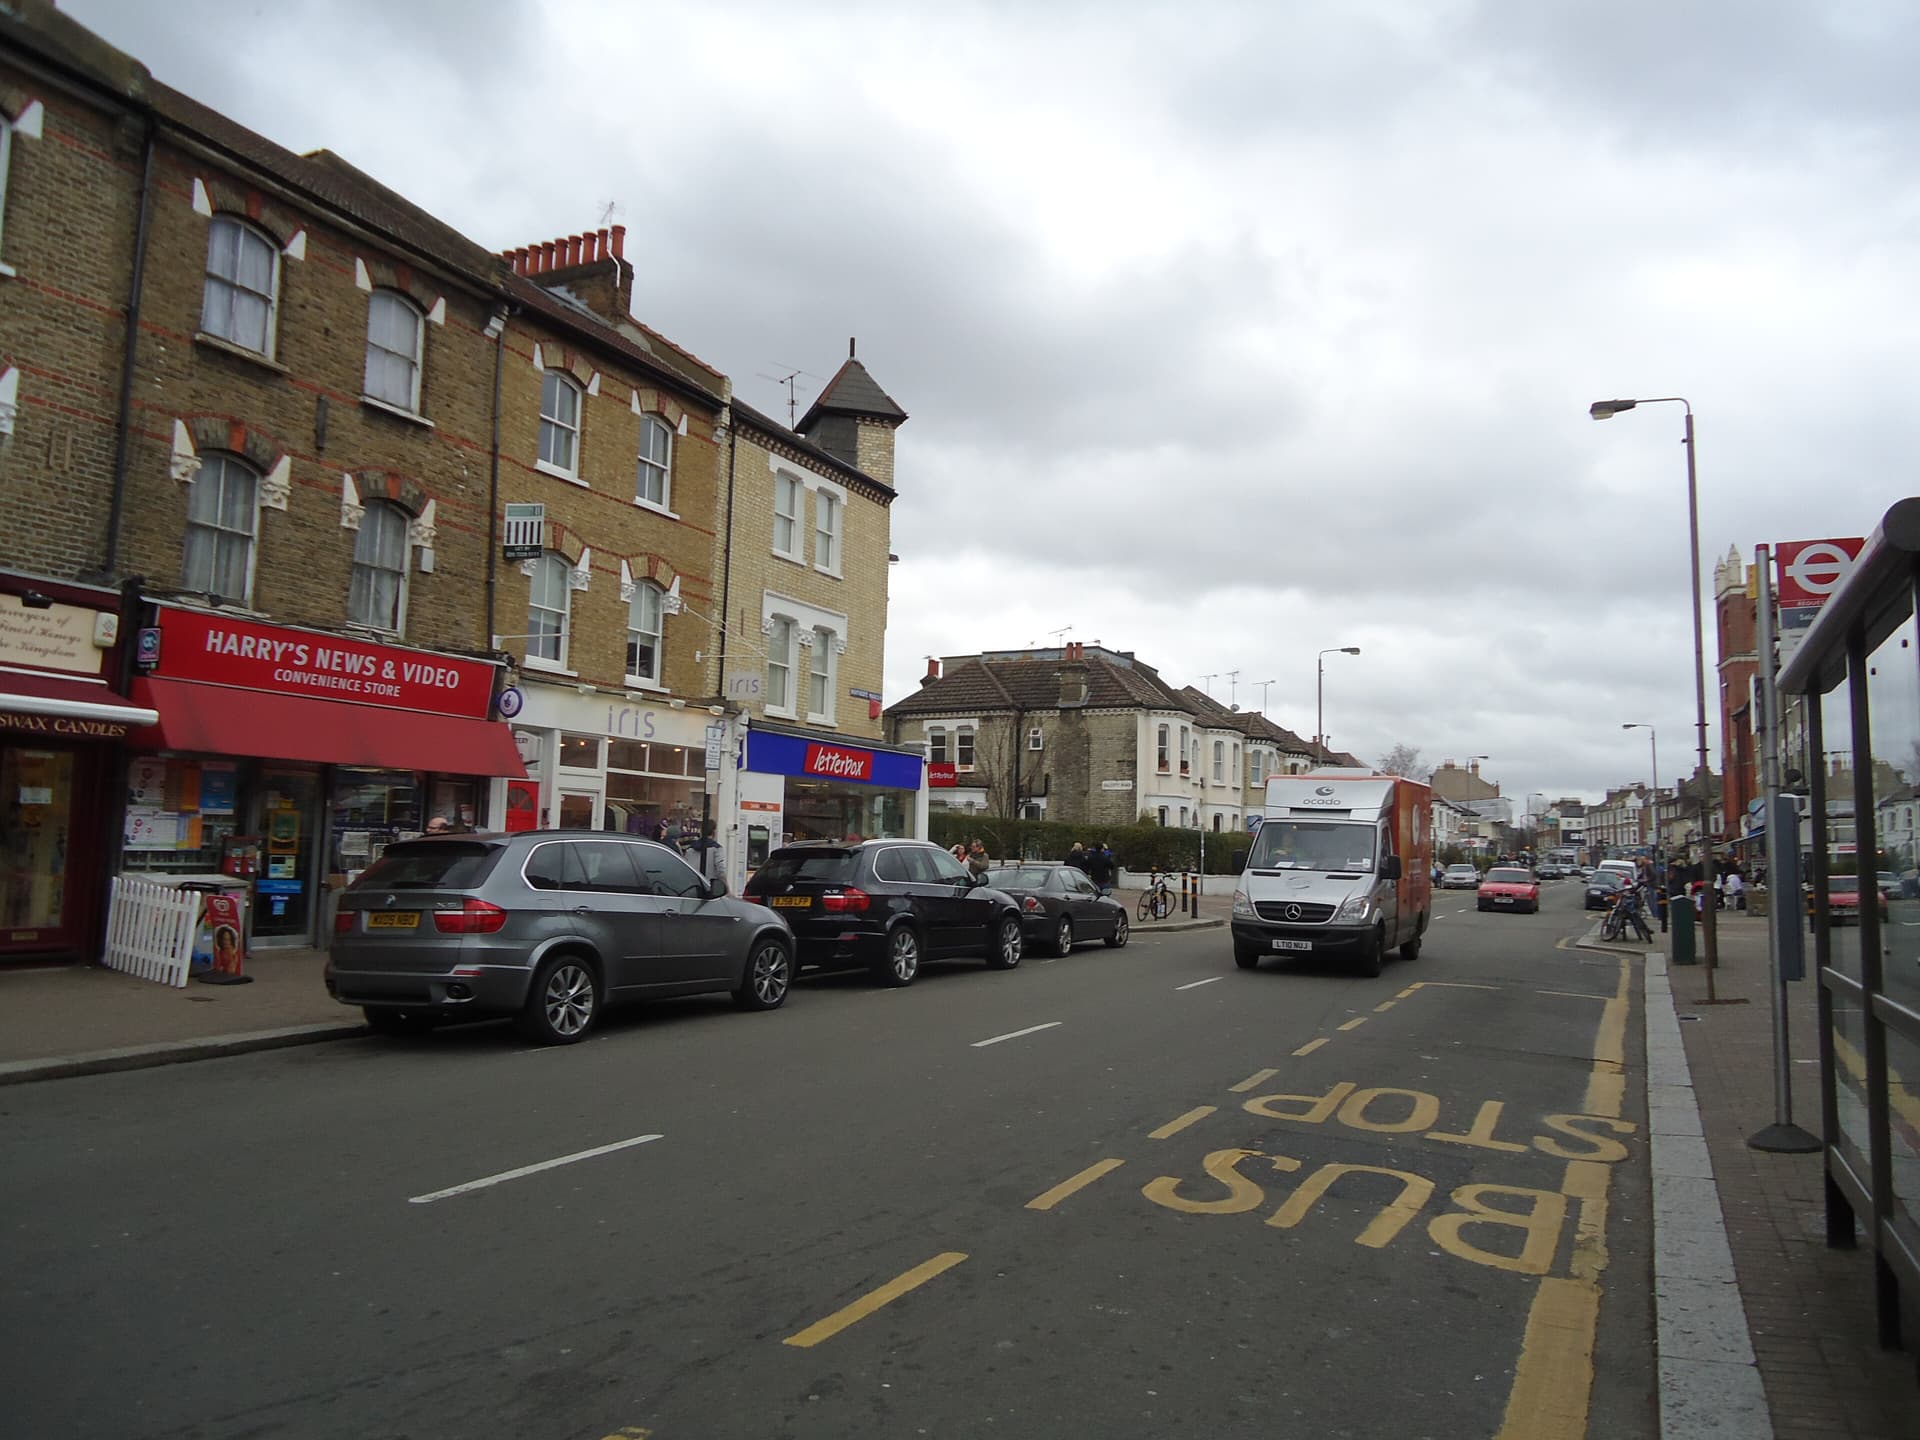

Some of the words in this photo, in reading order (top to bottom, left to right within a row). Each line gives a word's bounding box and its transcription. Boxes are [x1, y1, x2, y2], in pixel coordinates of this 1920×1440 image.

[56, 615, 72, 628] of
[205, 630, 310, 665] HARRY'S
[315, 648, 377, 676] NEWS
[382, 660, 396, 680] &
[403, 662, 460, 689] VIDEO
[274, 669, 361, 692] CONVENIENCE
[363, 681, 401, 697] STORE
[729, 679, 759, 694] iris
[54, 719, 127, 737] CANDLES
[607, 705, 656, 739] iris
[813, 746, 865, 777] letterbox
[1303, 798, 1341, 806] ocado
[1242, 1081, 1639, 1162] STOP
[1141, 1147, 1568, 1276] BUS
